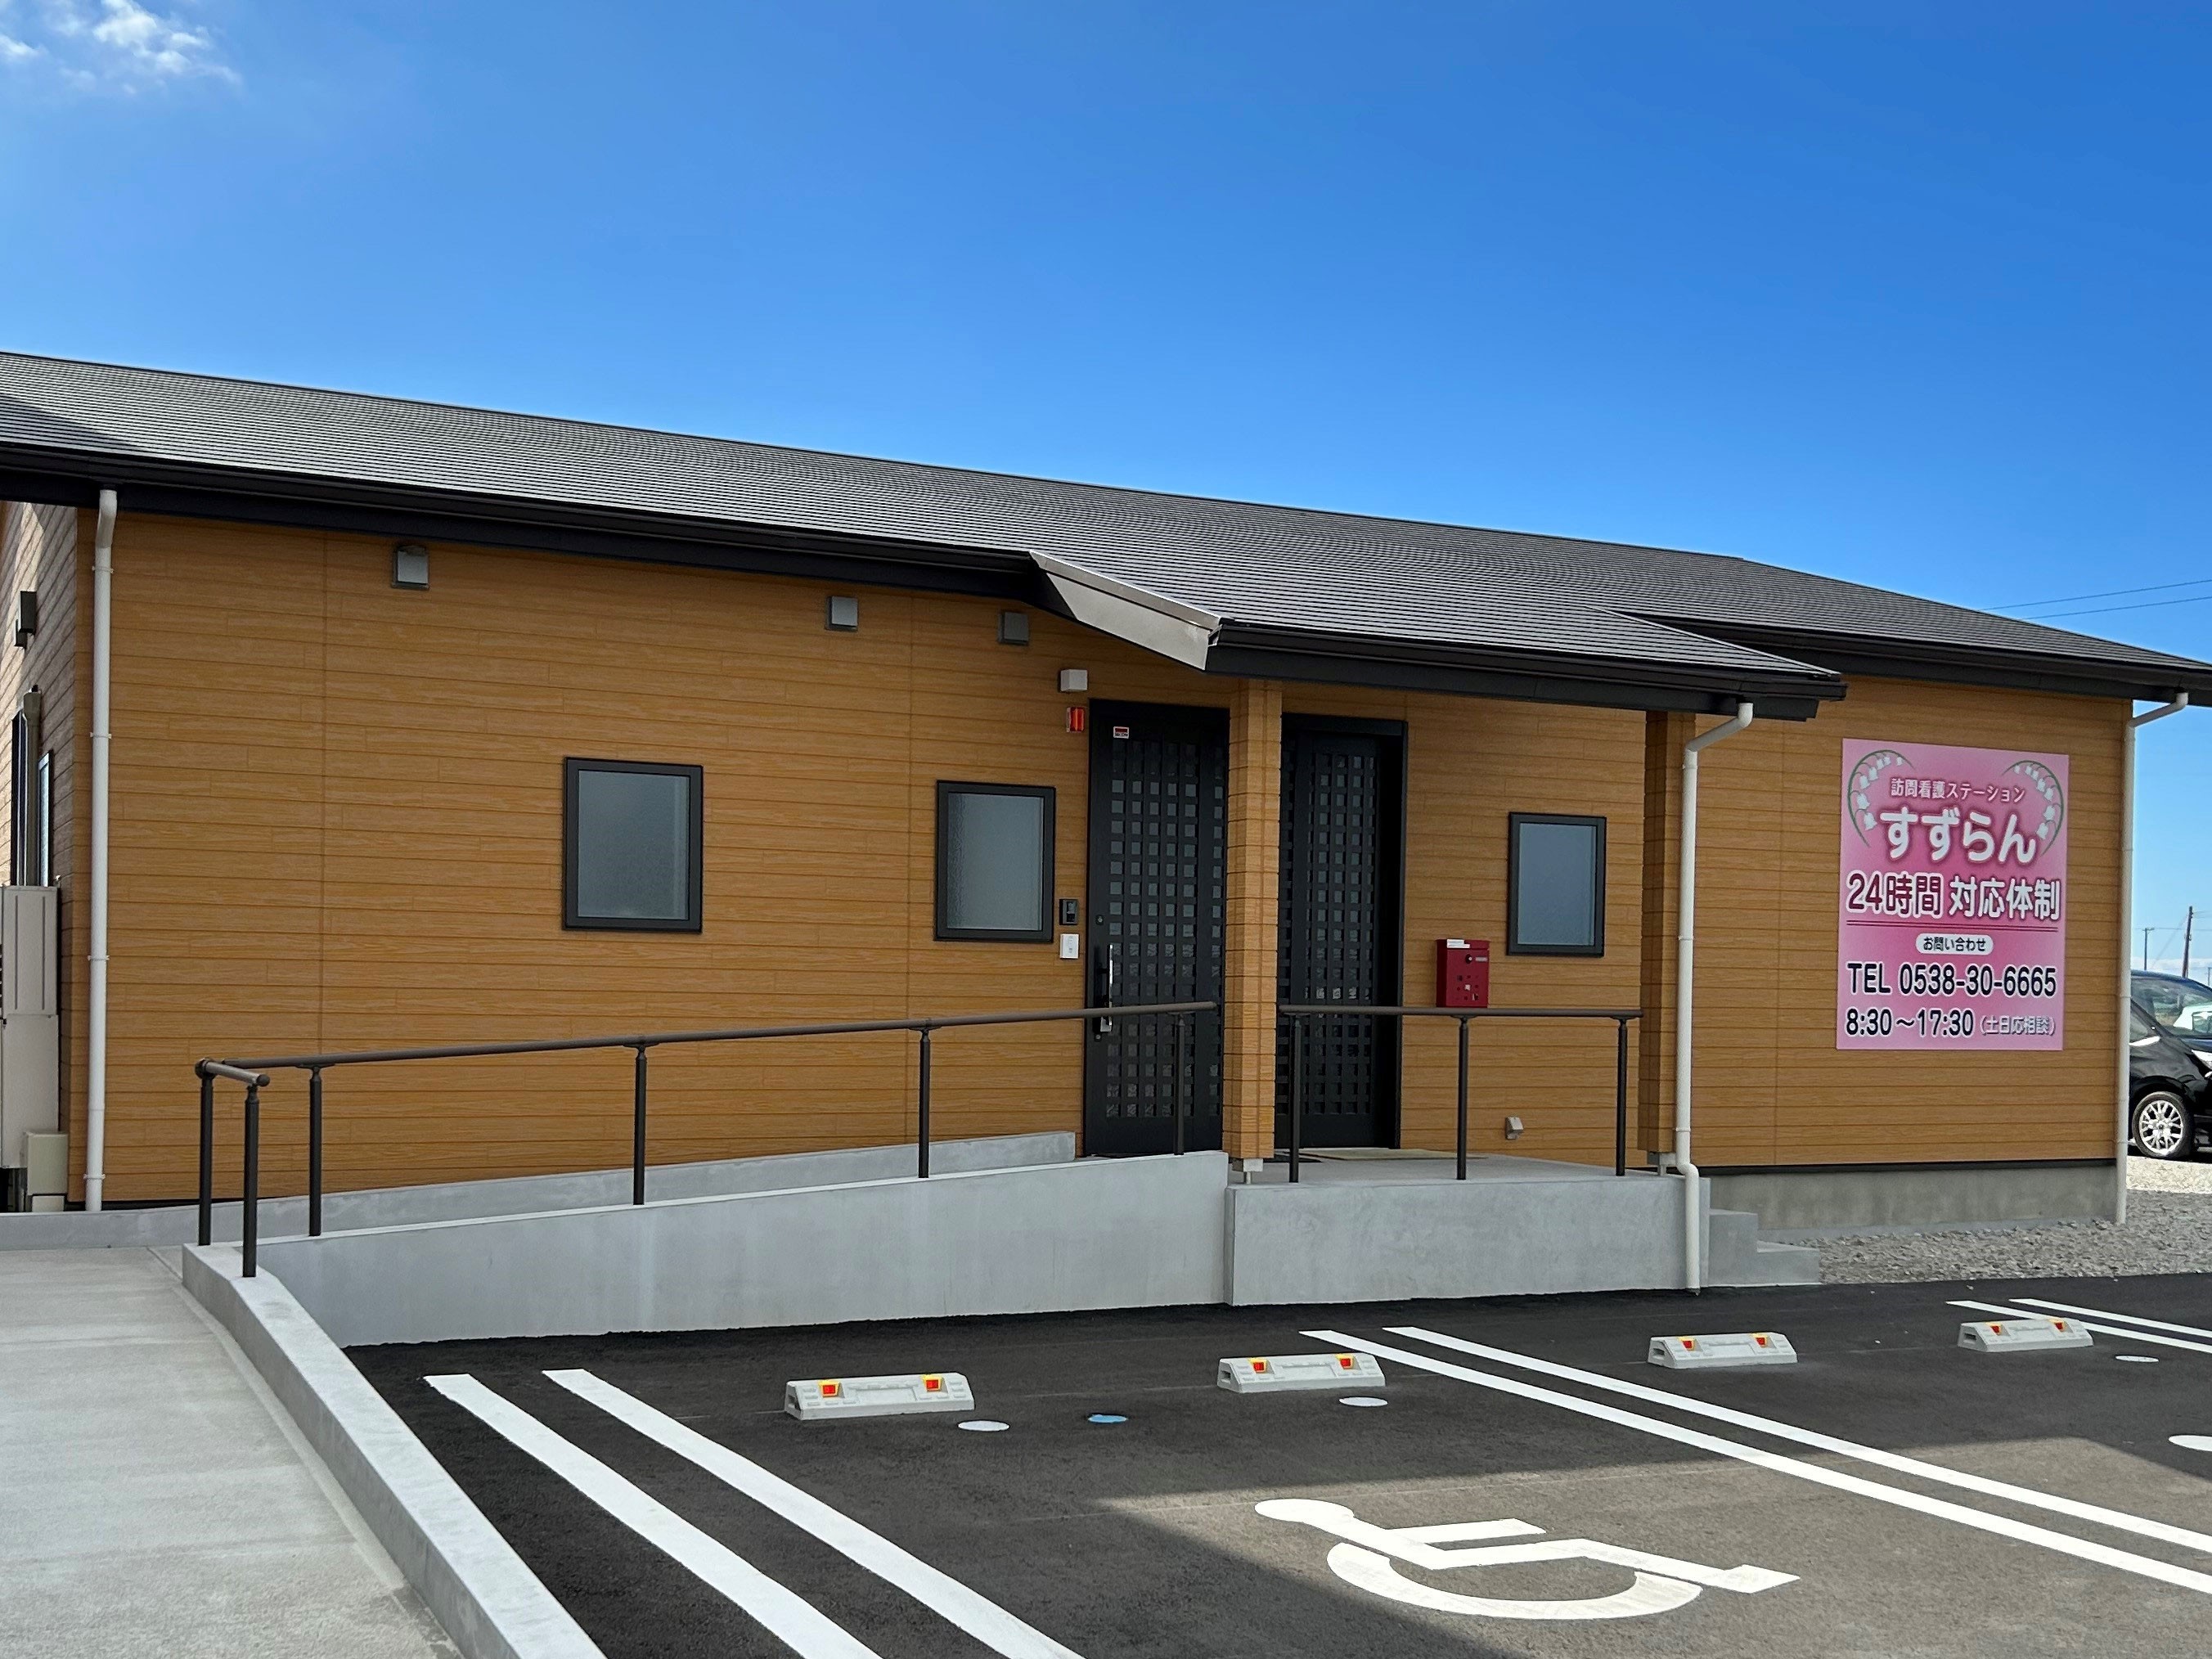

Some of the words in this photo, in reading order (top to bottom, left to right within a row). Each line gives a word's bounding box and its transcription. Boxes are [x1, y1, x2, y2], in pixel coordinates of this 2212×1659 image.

[1891, 778, 2026, 803] 訪問看護ステーション
[1879, 806, 2037, 864] すずらん
[1846, 872, 1941, 917] 24時間
[1949, 875, 2061, 920] 対応体制
[1922, 936, 1987, 953] お問い合わせ
[1847, 963, 1891, 994] TEL
[1899, 964, 2057, 997] 0538-30-6665
